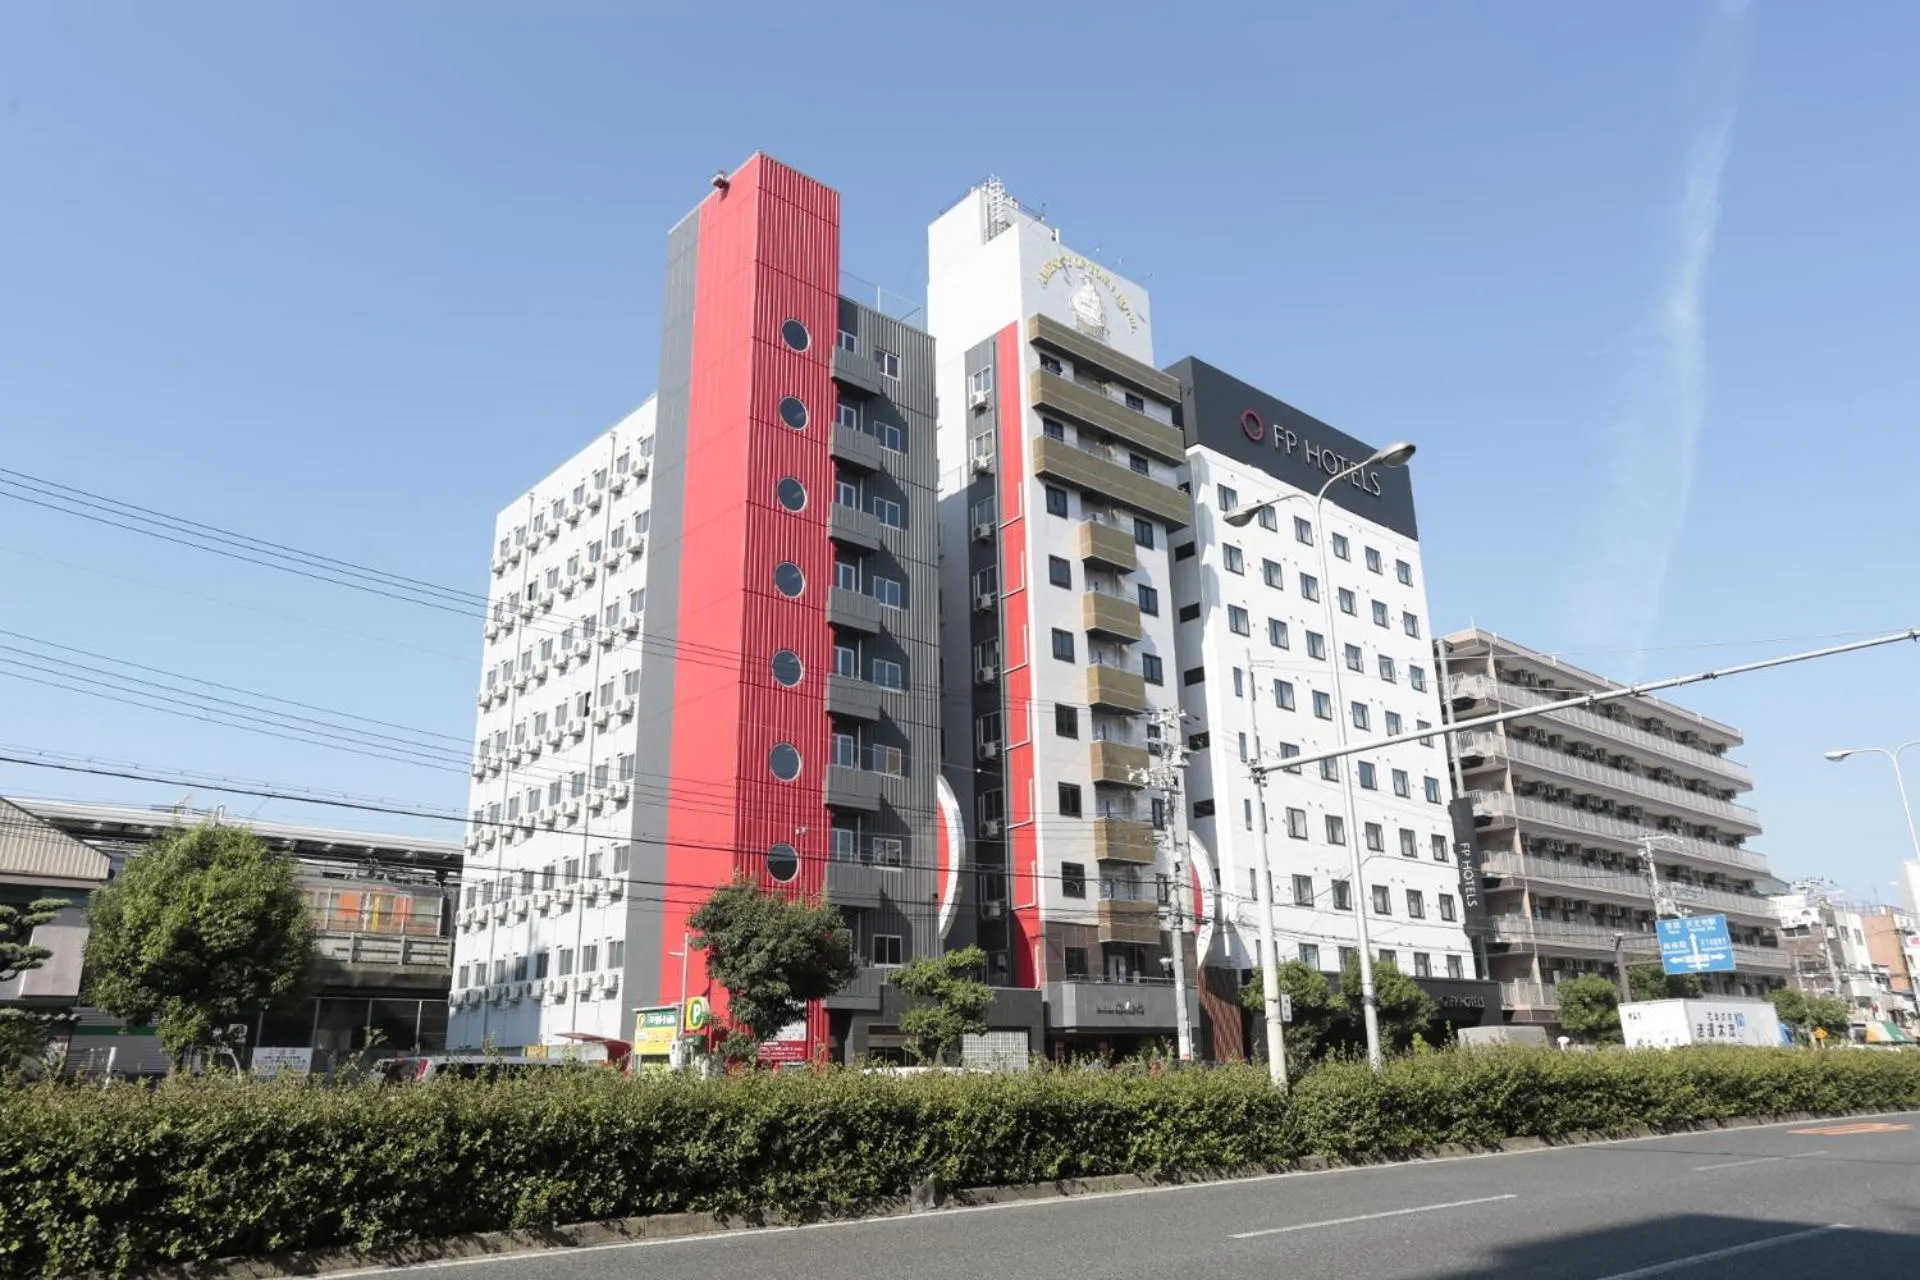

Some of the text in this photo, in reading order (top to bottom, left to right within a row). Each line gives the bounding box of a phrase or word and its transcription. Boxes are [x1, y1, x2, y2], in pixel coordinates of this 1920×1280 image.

[1273, 424, 1381, 497] FP HOTELS
[1460, 842, 1478, 907] FP HOTELS
[693, 1003, 701, 1024] P
